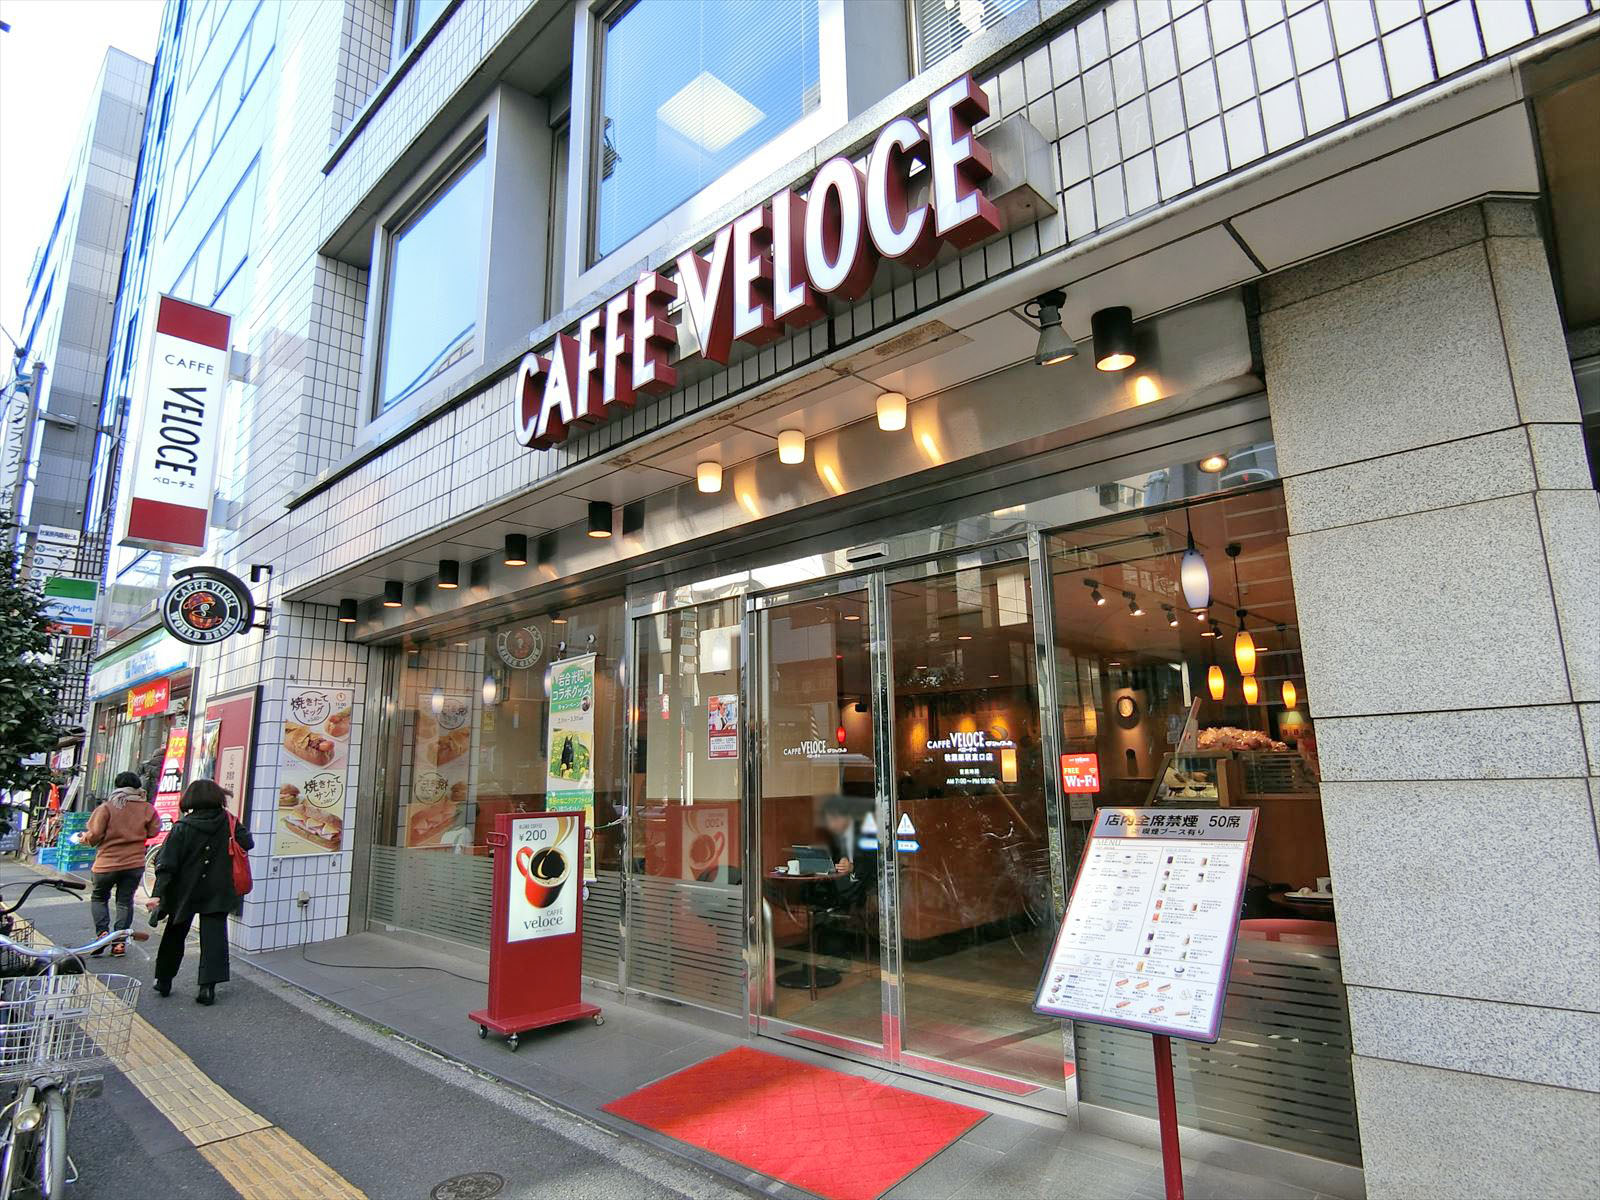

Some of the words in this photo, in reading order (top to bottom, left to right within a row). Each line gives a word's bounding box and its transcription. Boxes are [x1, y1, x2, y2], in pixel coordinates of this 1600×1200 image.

[677, 73, 1000, 363] VELOCE
[155, 387, 207, 476] VELOCE
[153, 476, 195, 489] ベローチェ
[211, 582, 238, 607] VELOCE
[170, 611, 201, 639] WORLD
[204, 617, 236, 640] BEANS
[291, 694, 329, 711] 焼きたて
[303, 705, 325, 718] ドッグ
[800, 740, 826, 754] VELOCE
[949, 731, 985, 748] VELOCE
[303, 775, 341, 794] 焼きたて
[314, 787, 337, 800] サンド
[1105, 814, 1199, 828] 店内全席禁煙
[1208, 815, 1241, 828] 50席
[519, 829, 547, 841] ¥200
[523, 915, 564, 930] veloce
